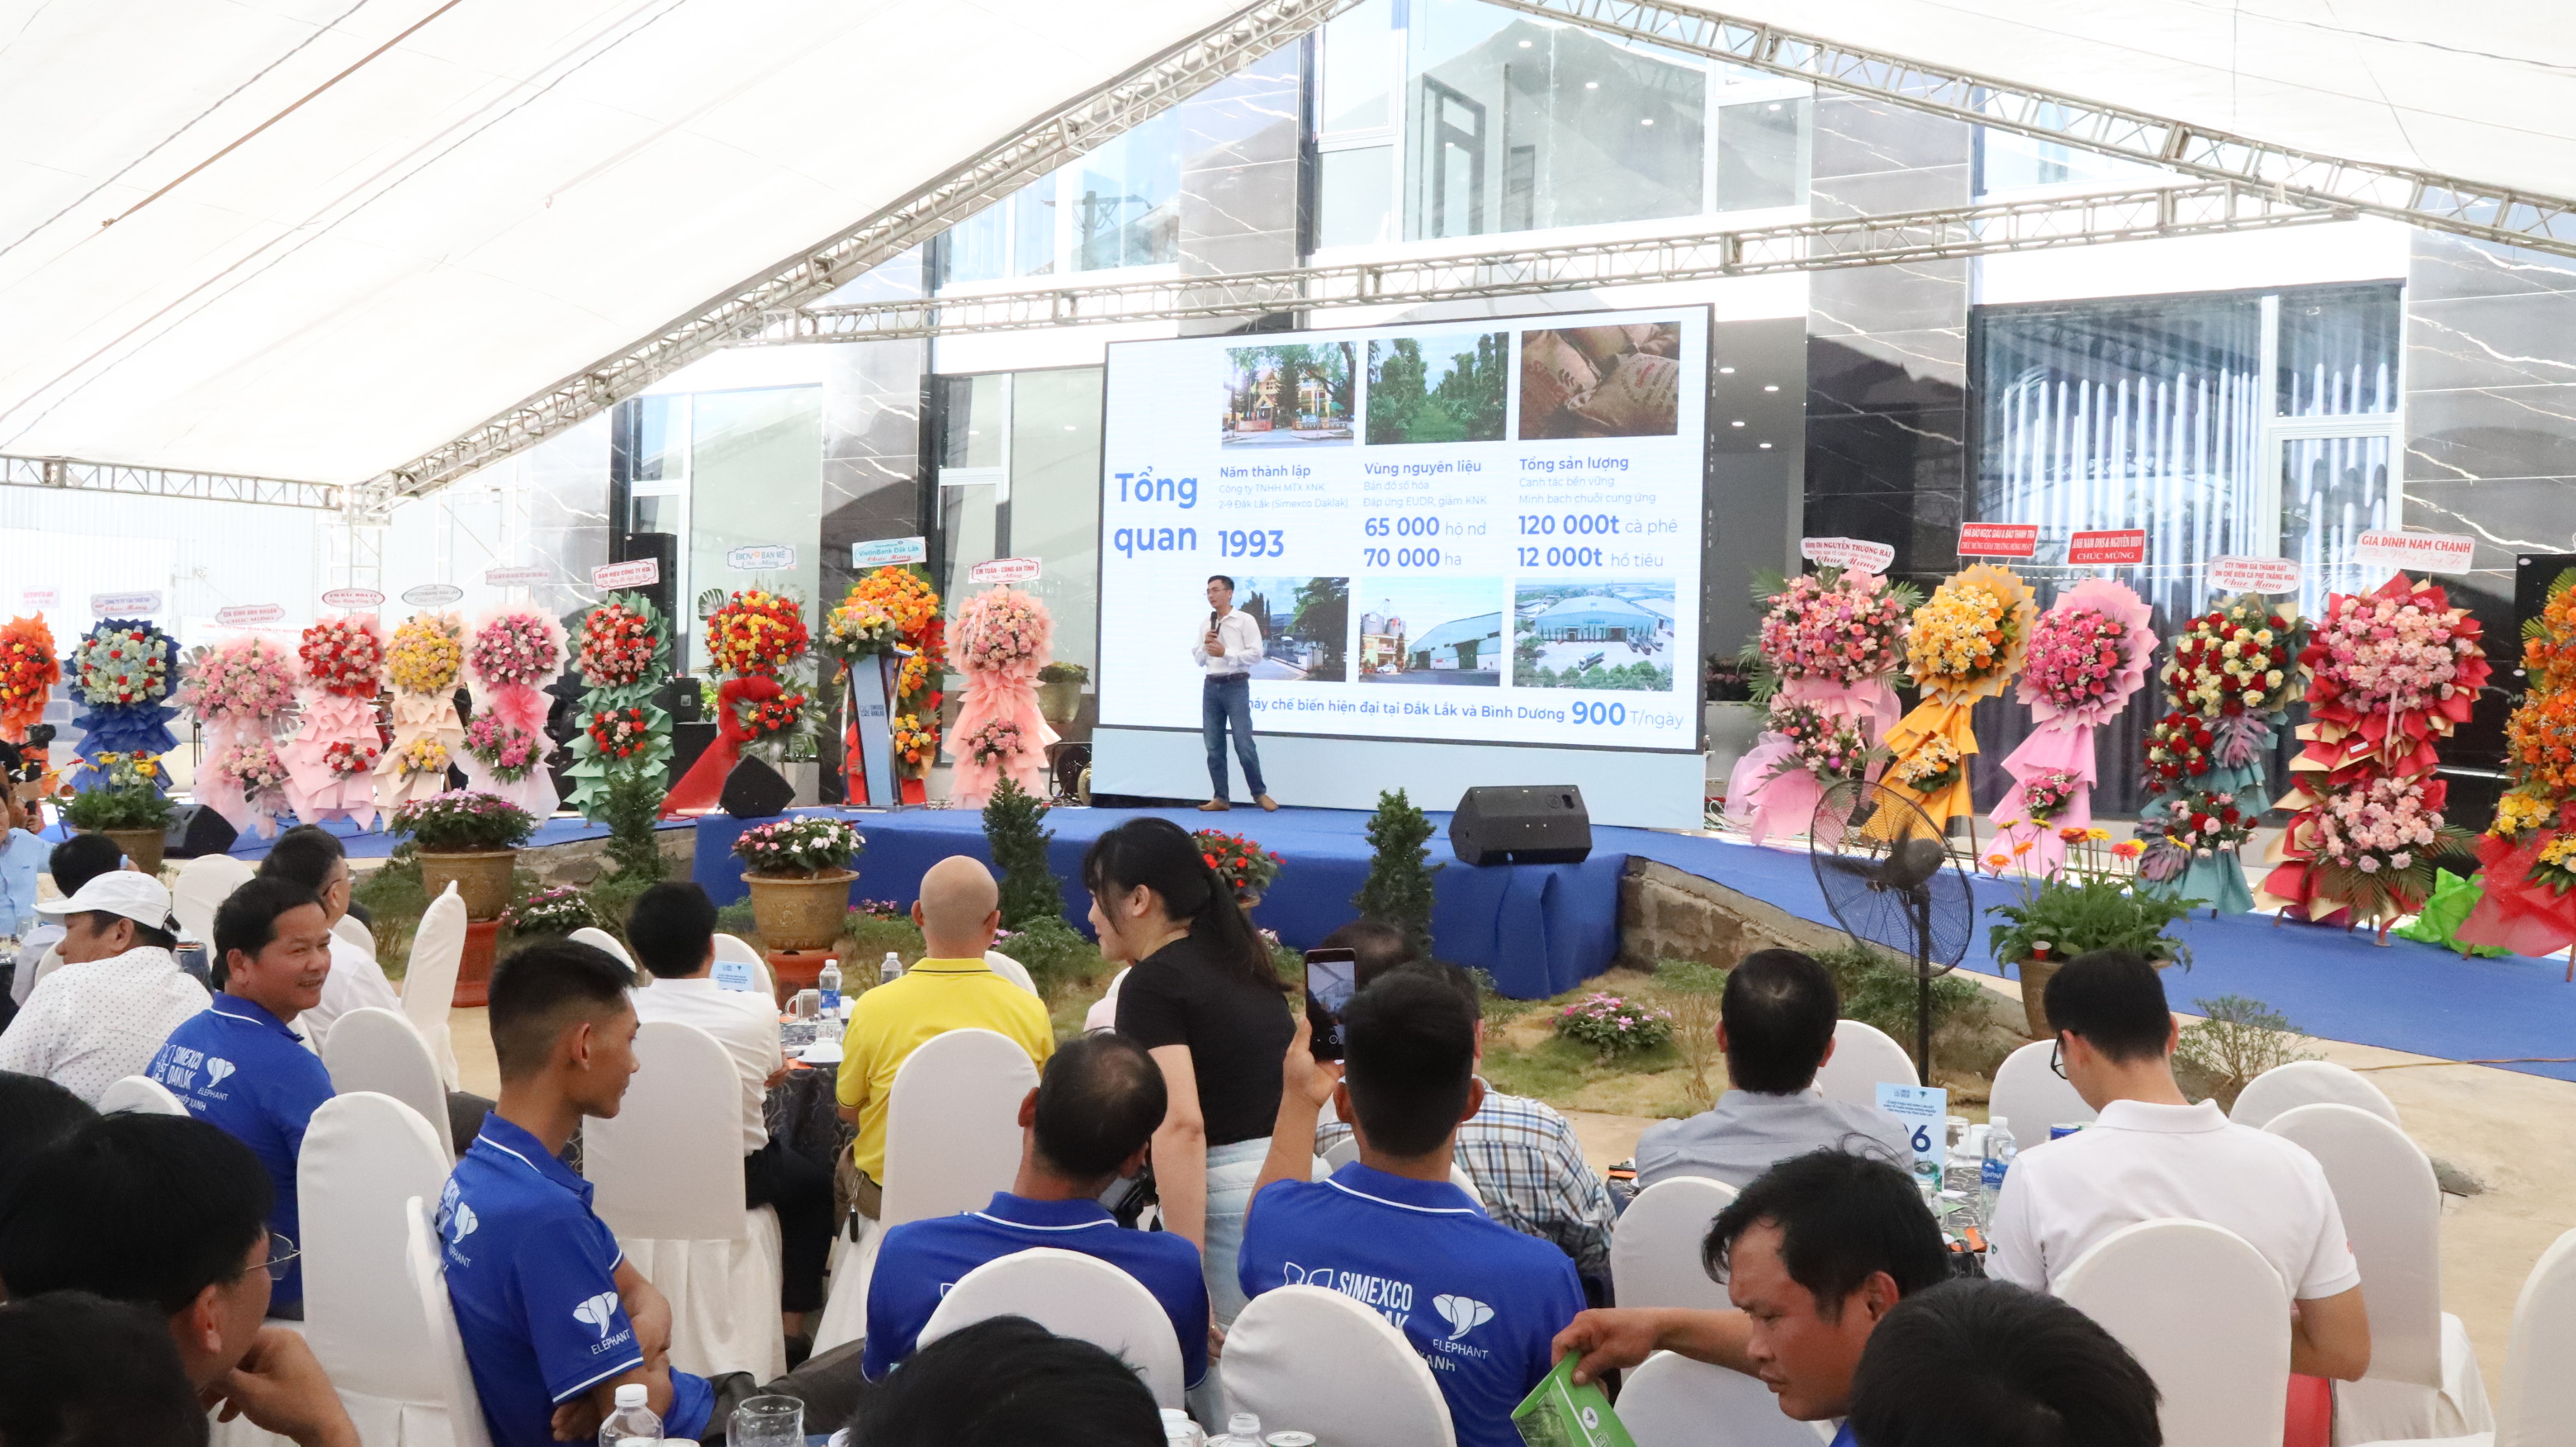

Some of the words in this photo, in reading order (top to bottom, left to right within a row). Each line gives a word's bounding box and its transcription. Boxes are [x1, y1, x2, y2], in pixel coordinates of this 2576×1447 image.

[1220, 467, 1248, 478] Năm
[1252, 465, 1288, 477] thành
[1292, 465, 1311, 479] lập
[1365, 462, 1399, 477] Vùng
[1404, 460, 1453, 476] nguyên
[1457, 459, 1482, 475] liệu
[1519, 456, 1555, 472] Tổng
[1559, 455, 1583, 469] sản
[1588, 456, 1629, 472] lượng
[1115, 466, 1198, 509] Tổng
[1219, 483, 1243, 494] Công
[1244, 484, 1253, 494] ty
[1255, 484, 1281, 493] TNHH
[1305, 482, 1325, 492] XNK
[1365, 517, 1390, 537] 65
[1397, 516, 1440, 537] 000
[1446, 522, 1463, 538] hộ
[1468, 521, 1486, 535] nd
[1518, 515, 1556, 534] 120
[1563, 514, 1620, 534] 000t
[1625, 519, 1643, 533] cà
[1648, 519, 1678, 535] phê
[859, 547, 893, 557] VietinBank
[893, 544, 906, 554] Đắk
[907, 544, 919, 553] Lắk
[1115, 527, 1197, 558] quan
[1218, 529, 1284, 557] 1993
[2361, 536, 2379, 546] GIA
[2409, 539, 2432, 550] NAM
[736, 552, 753, 561] BIDV
[761, 551, 775, 559] BAN
[1364, 548, 1390, 567] 70
[1397, 548, 1440, 567] 000
[1445, 553, 1461, 565] ha
[1518, 547, 1539, 567] 12
[1546, 547, 1603, 567] 000t
[1611, 552, 1630, 567] hồ
[1634, 554, 1664, 567] tiêu
[2076, 552, 2103, 560] CHÚC
[2105, 550, 2134, 559] MỪNG
[1271, 697, 1294, 709] chế
[1298, 698, 1324, 711] biến
[1328, 700, 1356, 715] hiện
[1360, 701, 1379, 716] đại
[1384, 702, 1399, 717] tại
[1404, 700, 1429, 714] Đắk
[1434, 701, 1457, 716] Lắk
[1462, 705, 1477, 717] và
[1481, 705, 1513, 718] Bình
[1518, 706, 1565, 723] Dương
[1572, 701, 1626, 726] 900
[1630, 709, 1683, 729] T/ngày
[173, 1046, 204, 1070] SIMEXCO
[167, 1065, 197, 1090] DAKLAK
[197, 1087, 229, 1101] ELEPHANT
[189, 1098, 206, 1112] XANH
[1337, 1270, 1413, 1312] SIMEXCO
[590, 1329, 630, 1354] ELEPHANT
[1432, 1338, 1488, 1359] ELEPHANT
